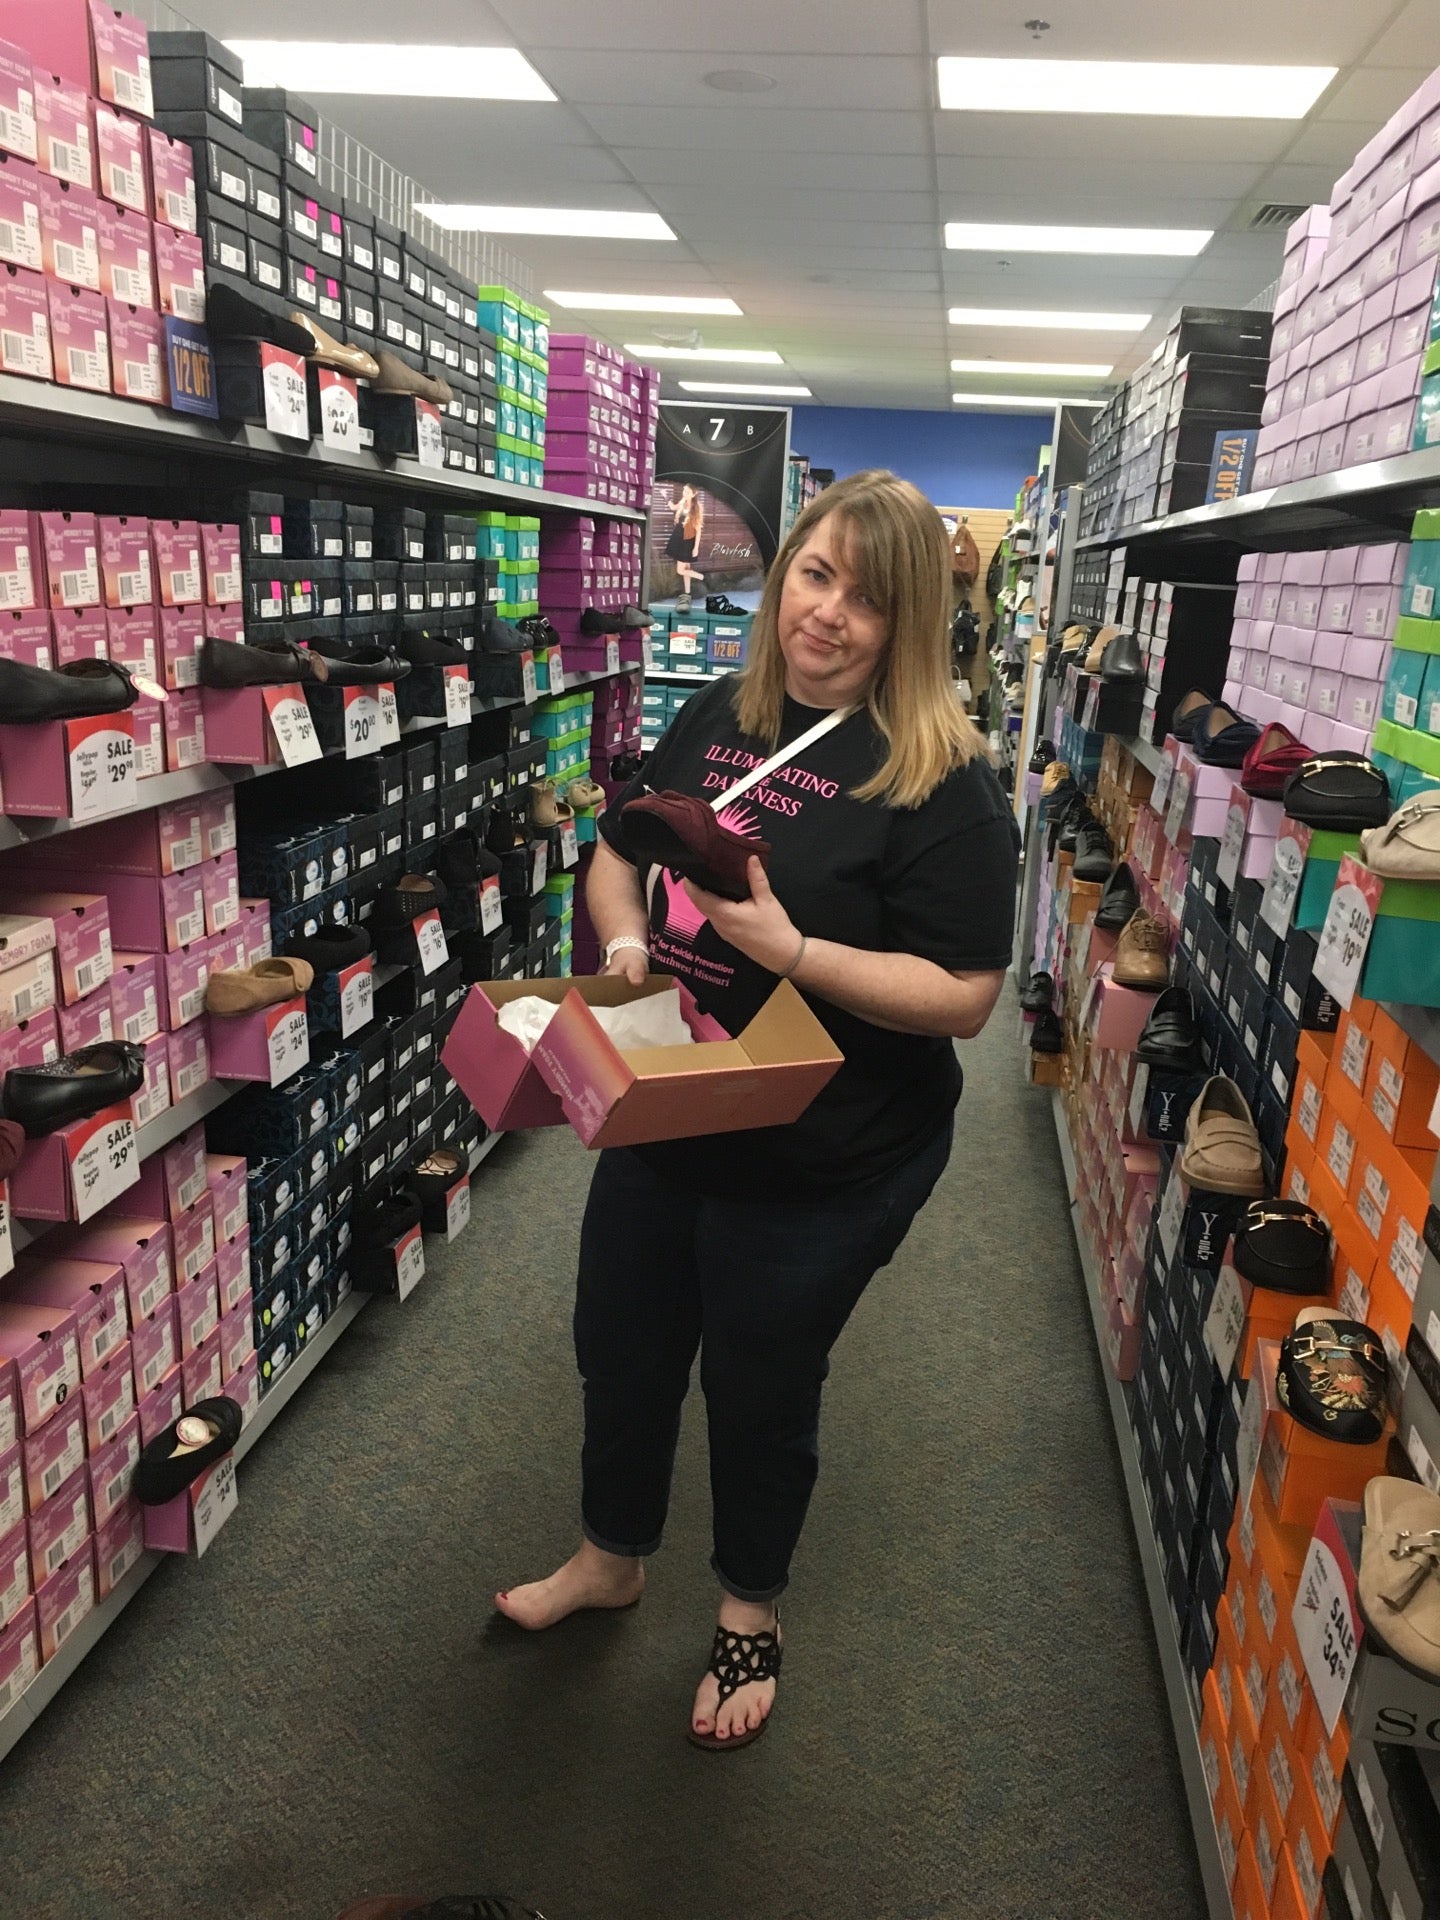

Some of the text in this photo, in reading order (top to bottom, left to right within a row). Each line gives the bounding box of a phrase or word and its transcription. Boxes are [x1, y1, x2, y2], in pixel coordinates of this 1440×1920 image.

[173, 345, 210, 399] 1/2 OFF
[287, 377, 304, 395] SALE
[683, 418, 754, 441] A 7 B
[1219, 438, 1243, 466] 1/2
[710, 542, 753, 558] Blowfish
[51, 583, 60, 596] W
[713, 643, 740, 658] 1/2 OFF
[458, 682, 468, 693] SALE
[381, 694, 395, 708] SALE
[291, 706, 309, 721] SALE
[76, 751, 98, 763] Jellypop
[107, 739, 132, 759] SALE
[704, 744, 839, 799] ILLUMATING
[430, 922, 441, 936] SALE
[1349, 907, 1370, 939] SALE
[0, 944, 28, 965] EMORY
[658, 939, 670, 950] for
[669, 944, 694, 961] Suicide
[694, 955, 735, 975] Prevention
[358, 975, 371, 992] SALE
[693, 968, 730, 987] Missouri
[289, 1014, 305, 1034] SALE
[107, 1121, 131, 1150] SALE
[99, 1309, 107, 1323] W
[215, 1458, 232, 1488] SALE
[1331, 1596, 1354, 1659] SALE
